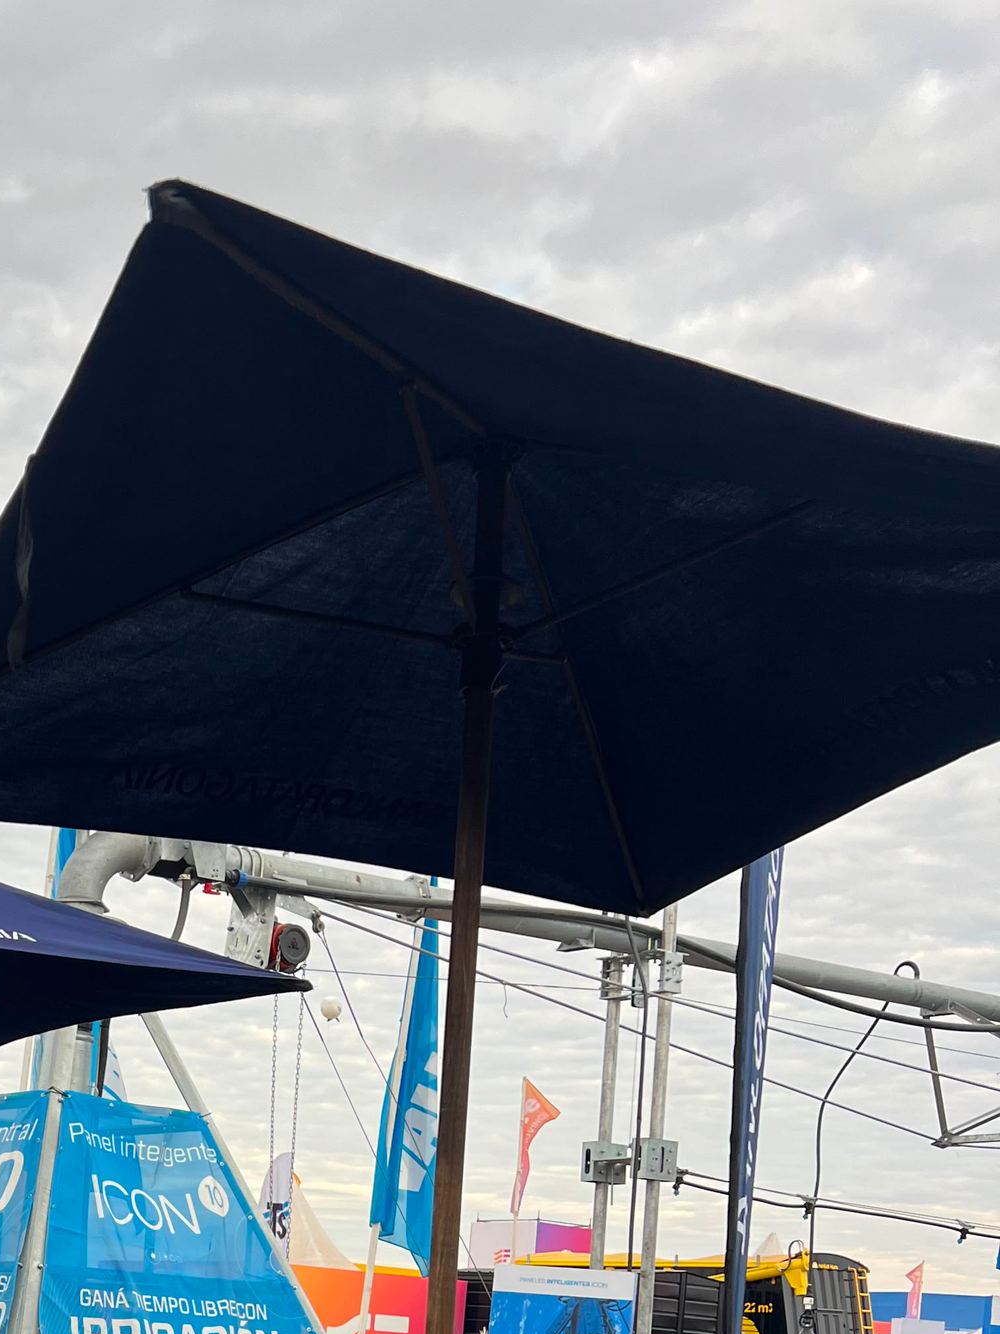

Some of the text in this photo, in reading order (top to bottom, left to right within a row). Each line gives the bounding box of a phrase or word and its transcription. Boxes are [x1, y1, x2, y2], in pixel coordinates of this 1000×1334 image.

[69, 1123, 117, 1154] Panel
[91, 1174, 225, 1234] ICON 10
[80, 1287, 129, 1309] GANÁ
[131, 1291, 190, 1315] TIEMPO
